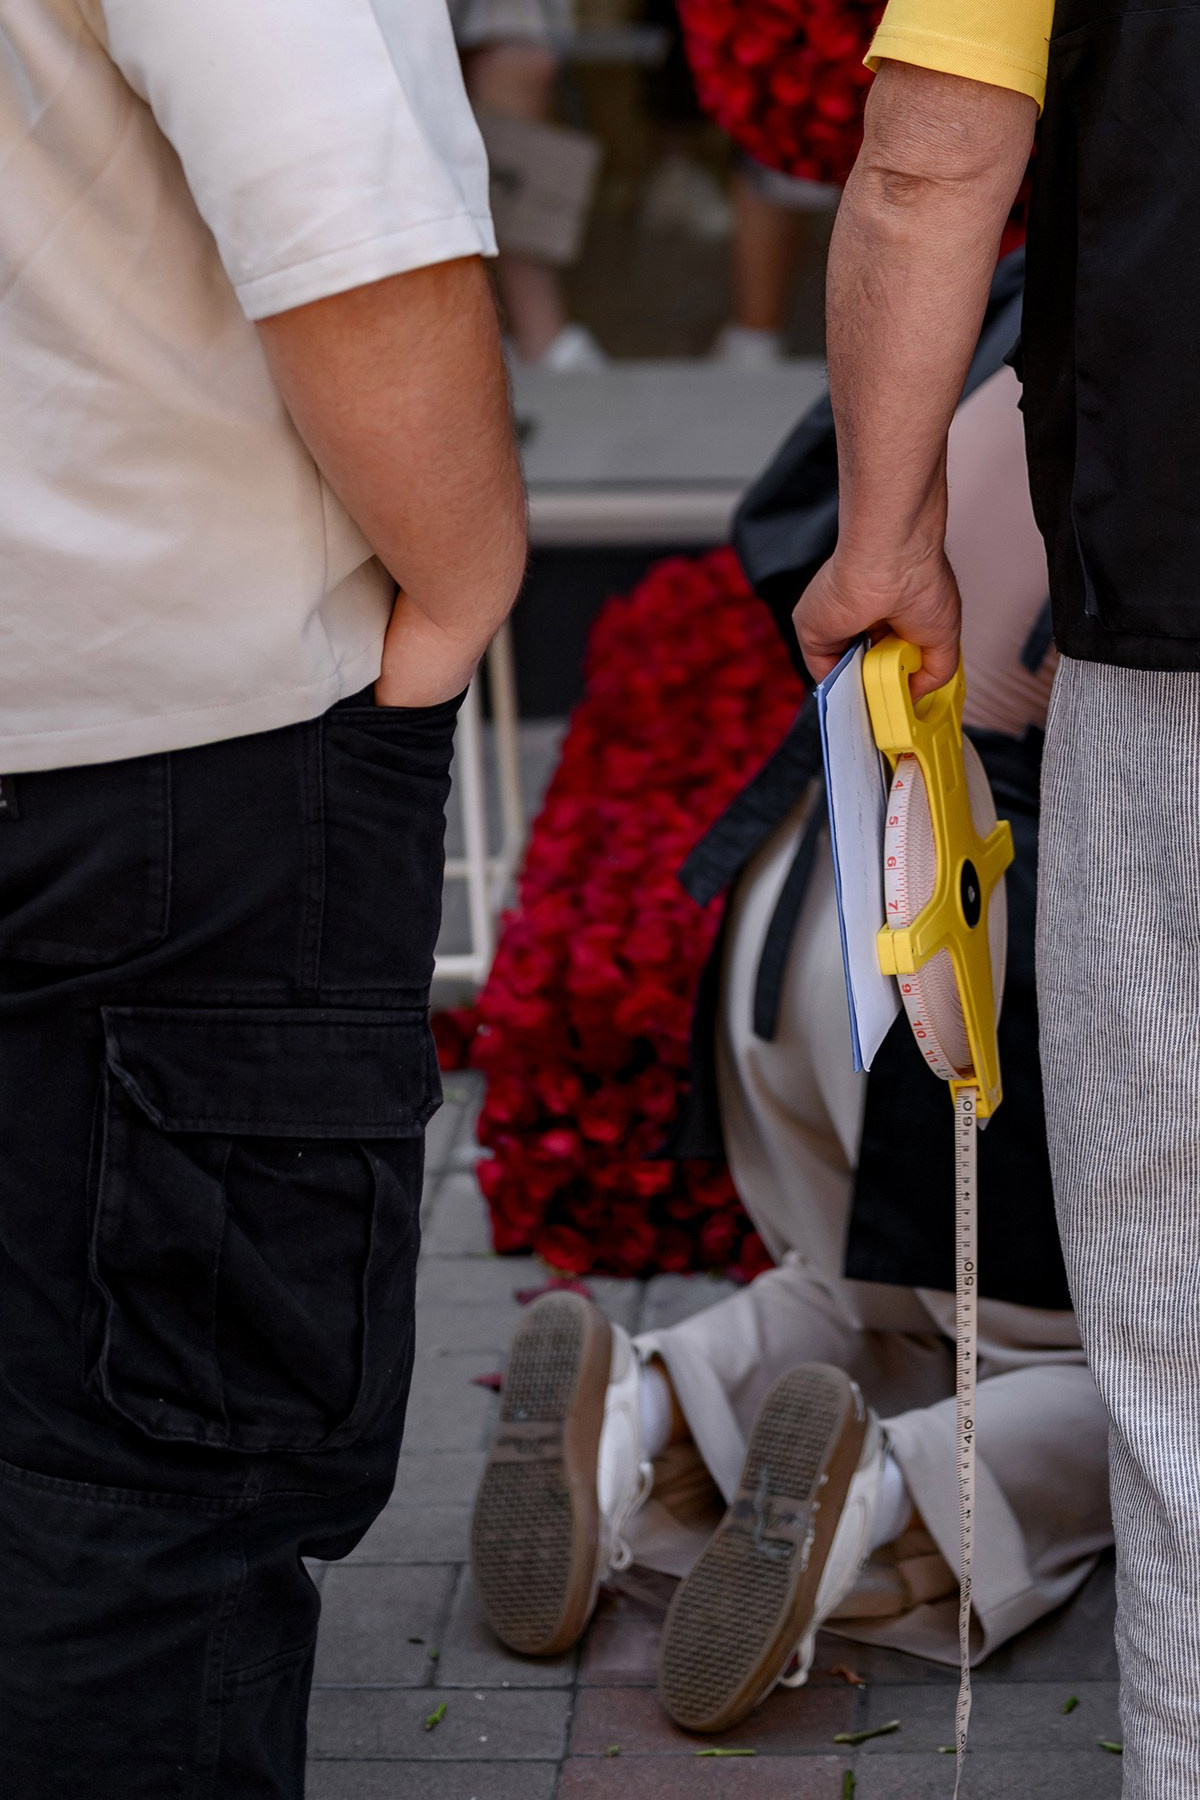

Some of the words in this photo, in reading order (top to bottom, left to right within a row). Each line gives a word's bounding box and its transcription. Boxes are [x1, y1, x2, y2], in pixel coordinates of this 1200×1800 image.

[888, 816, 899, 825] 5
[887, 856, 897, 867] 6
[888, 899, 898, 911] 7
[901, 983, 912, 993] 9
[913, 1020, 927, 1039] 10
[925, 1050, 938, 1063] 11
[963, 1100, 973, 1127] 60
[963, 1261, 974, 1286] 50
[963, 1419, 974, 1444] 40
